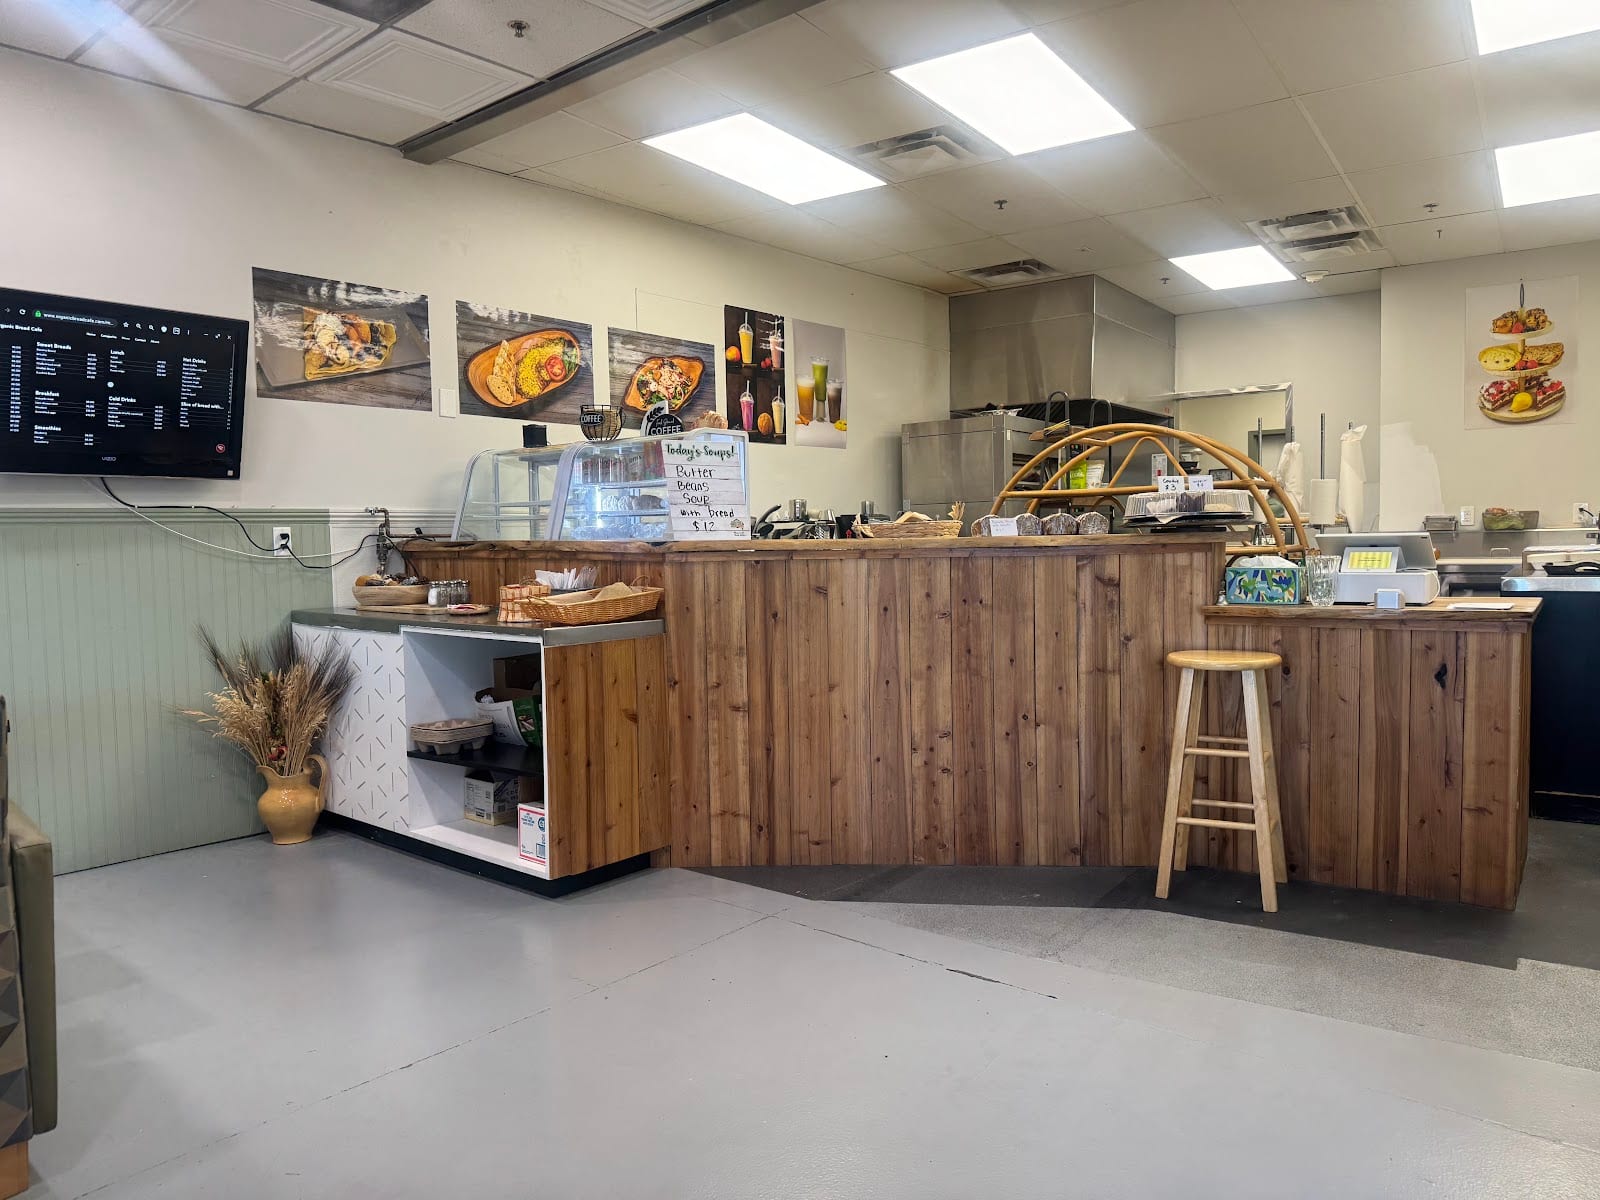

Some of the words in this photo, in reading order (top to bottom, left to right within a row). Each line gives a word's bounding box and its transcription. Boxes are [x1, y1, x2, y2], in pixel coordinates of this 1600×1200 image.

[580, 414, 602, 423] COFFEE
[34, 424, 62, 432] Smoothies
[650, 424, 682, 436] COFFEE
[665, 443, 701, 462] Today's
[703, 445, 736, 461] Soups!
[676, 465, 716, 478] Butter
[677, 480, 710, 492] Beans
[682, 492, 710, 506] Soup
[680, 508, 701, 518] with
[707, 505, 735, 518] bread
